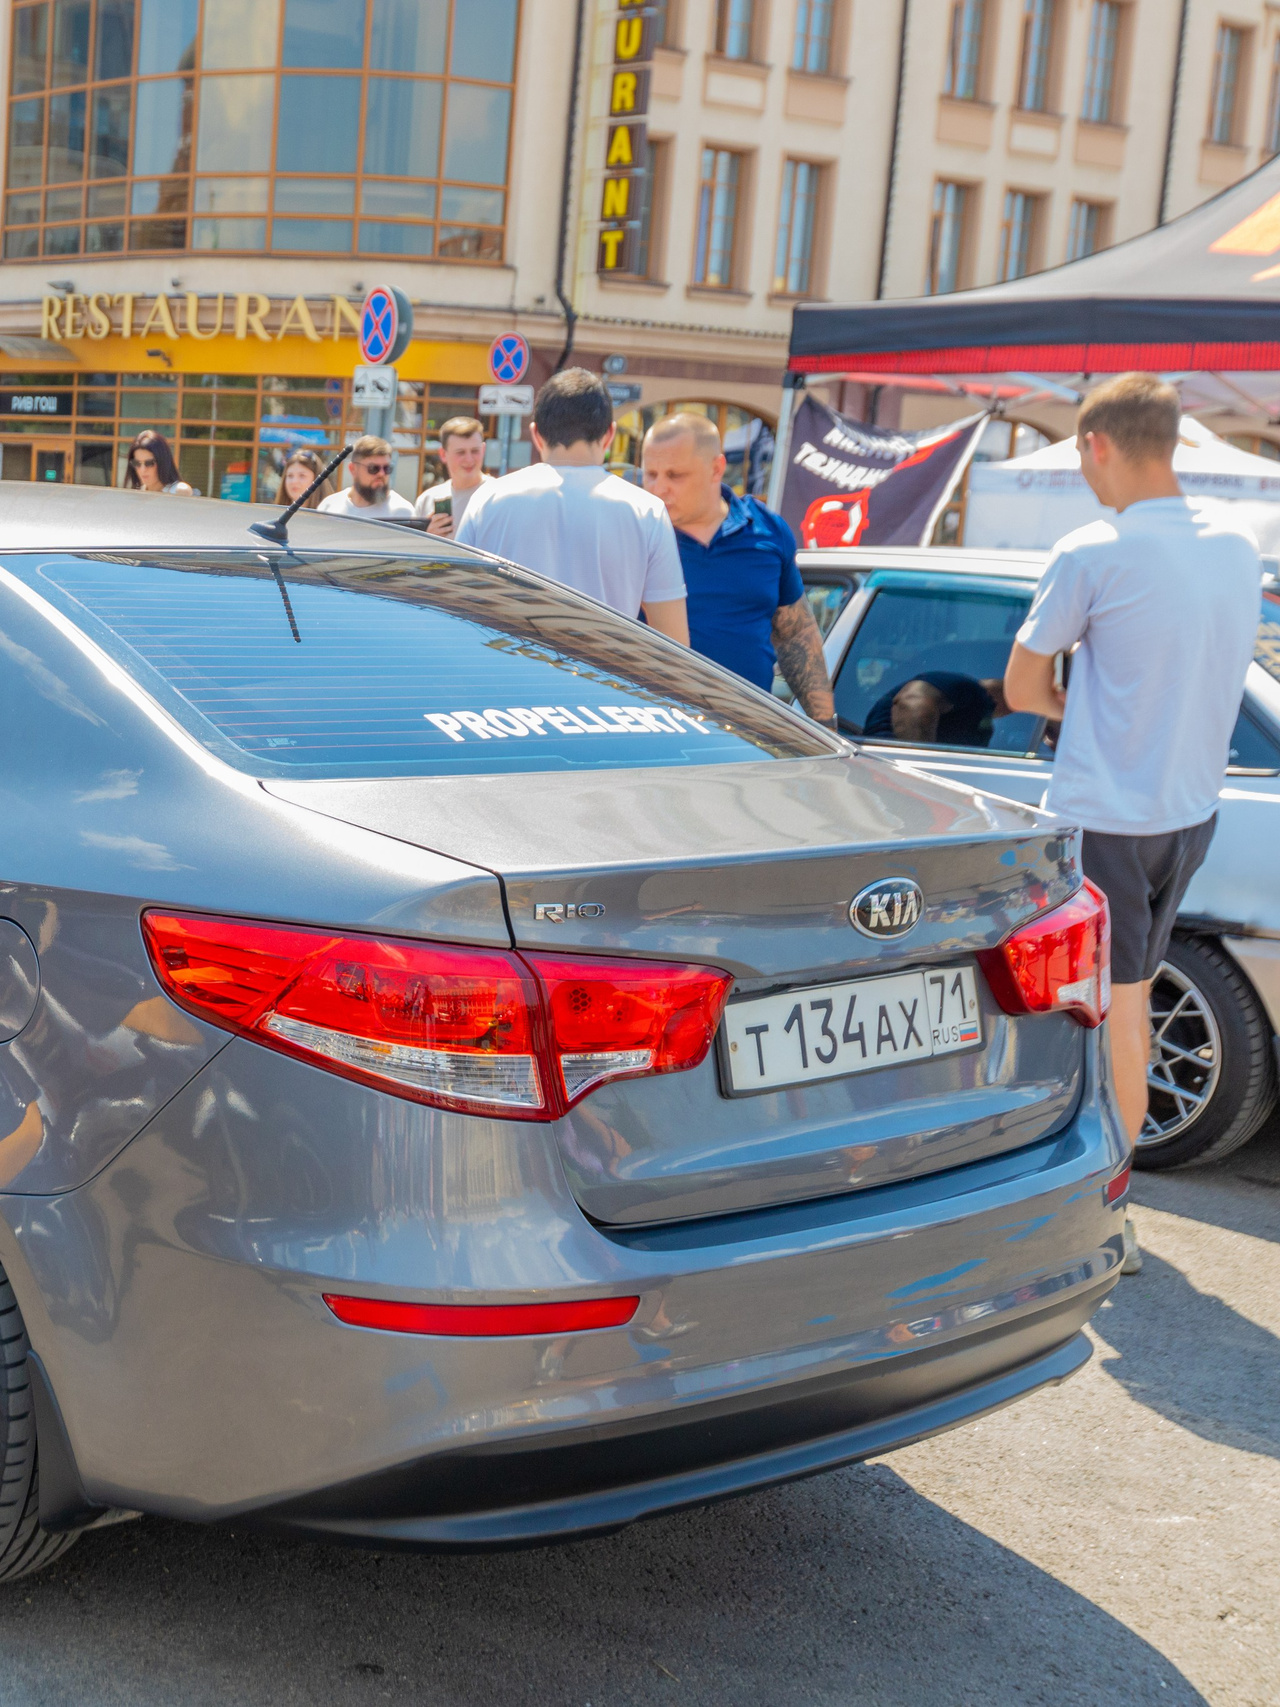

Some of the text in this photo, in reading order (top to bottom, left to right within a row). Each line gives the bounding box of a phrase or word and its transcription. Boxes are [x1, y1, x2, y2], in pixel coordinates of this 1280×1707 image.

[600, 0, 644, 270] URANT
[423, 705, 710, 742] PROPELLER71
[534, 902, 607, 924] RIO
[868, 890, 918, 928] KIA
[928, 971, 969, 1025] 71
[931, 1024, 960, 1047] RUS
